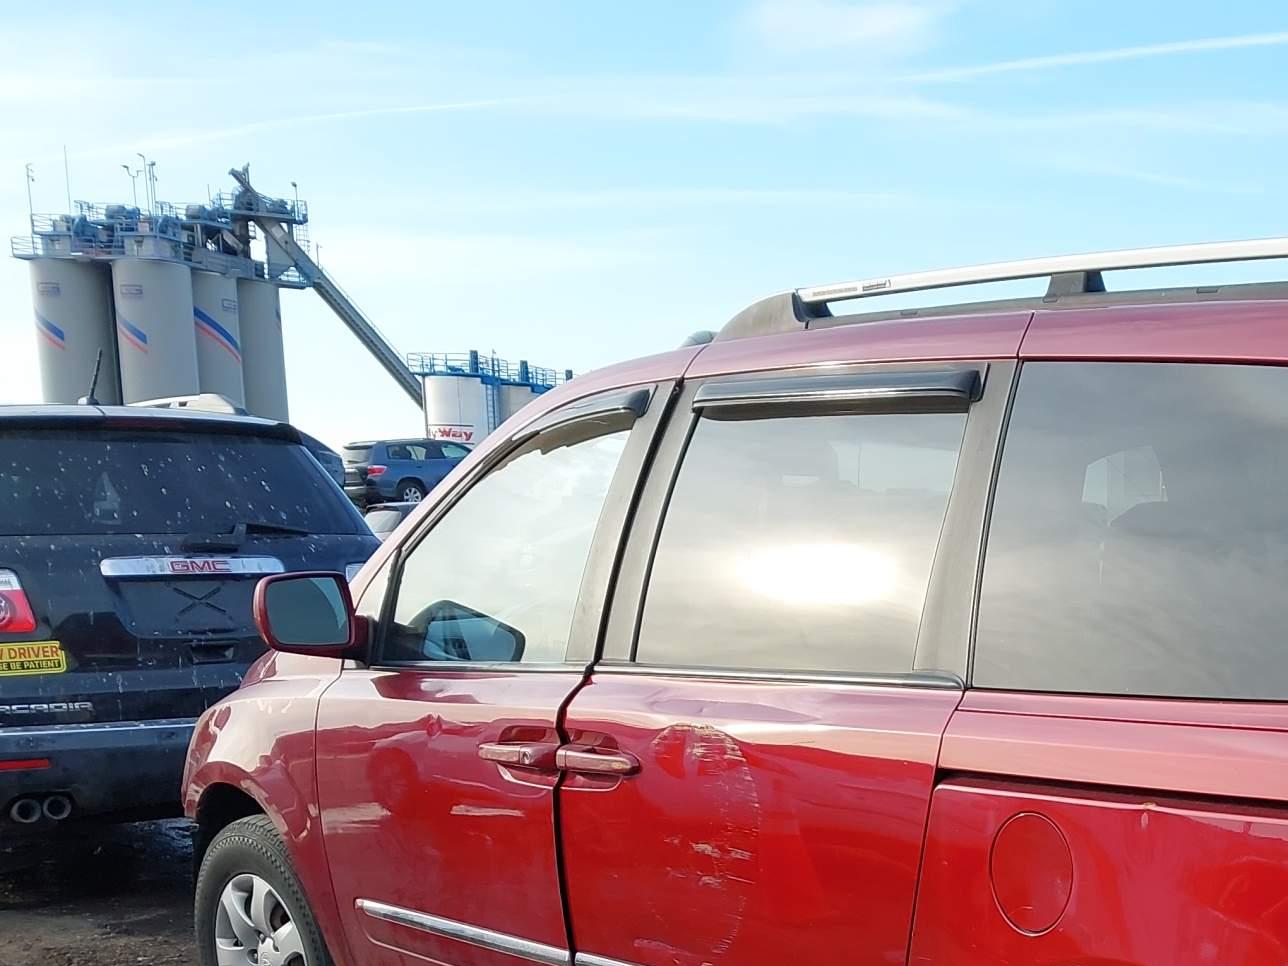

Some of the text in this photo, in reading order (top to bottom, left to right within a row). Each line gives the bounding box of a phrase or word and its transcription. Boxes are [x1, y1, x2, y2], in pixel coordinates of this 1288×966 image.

[169, 560, 232, 573] GMC
[8, 645, 60, 660] DRIVER
[23, 659, 60, 669] PATIENT
